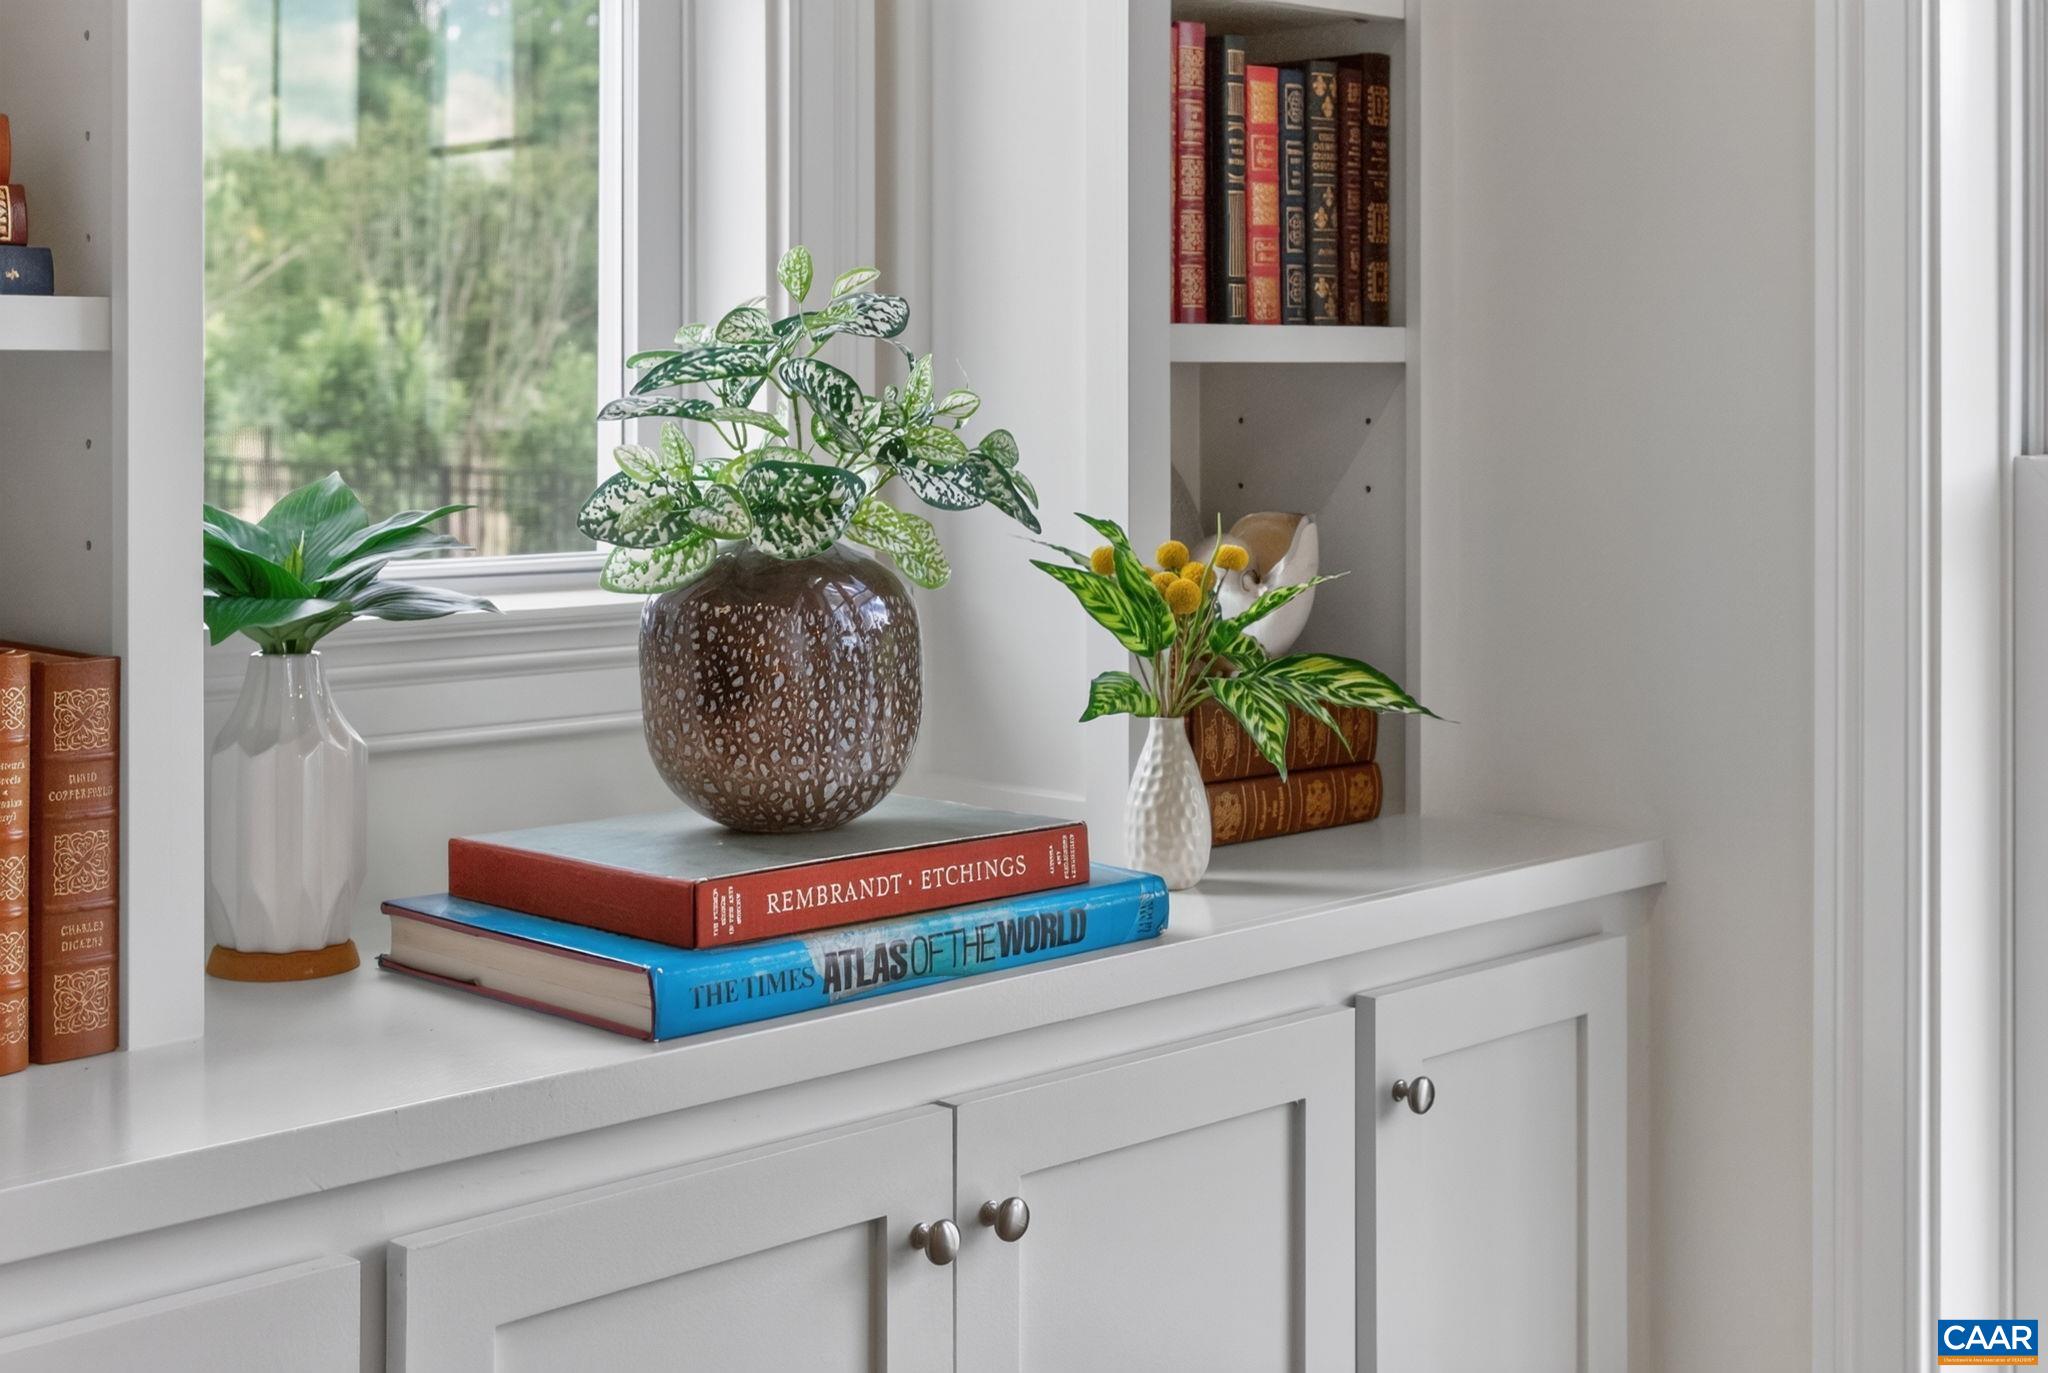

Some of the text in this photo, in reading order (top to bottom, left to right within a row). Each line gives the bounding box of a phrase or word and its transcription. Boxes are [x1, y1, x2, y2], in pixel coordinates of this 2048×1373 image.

[766, 873, 904, 915] REMBRANDT
[920, 854, 1027, 890] ETCHINGS
[689, 979, 738, 1010] THE
[741, 965, 816, 999] TIMES
[821, 938, 908, 995] ATLAS
[997, 908, 1087, 958] WORLD
